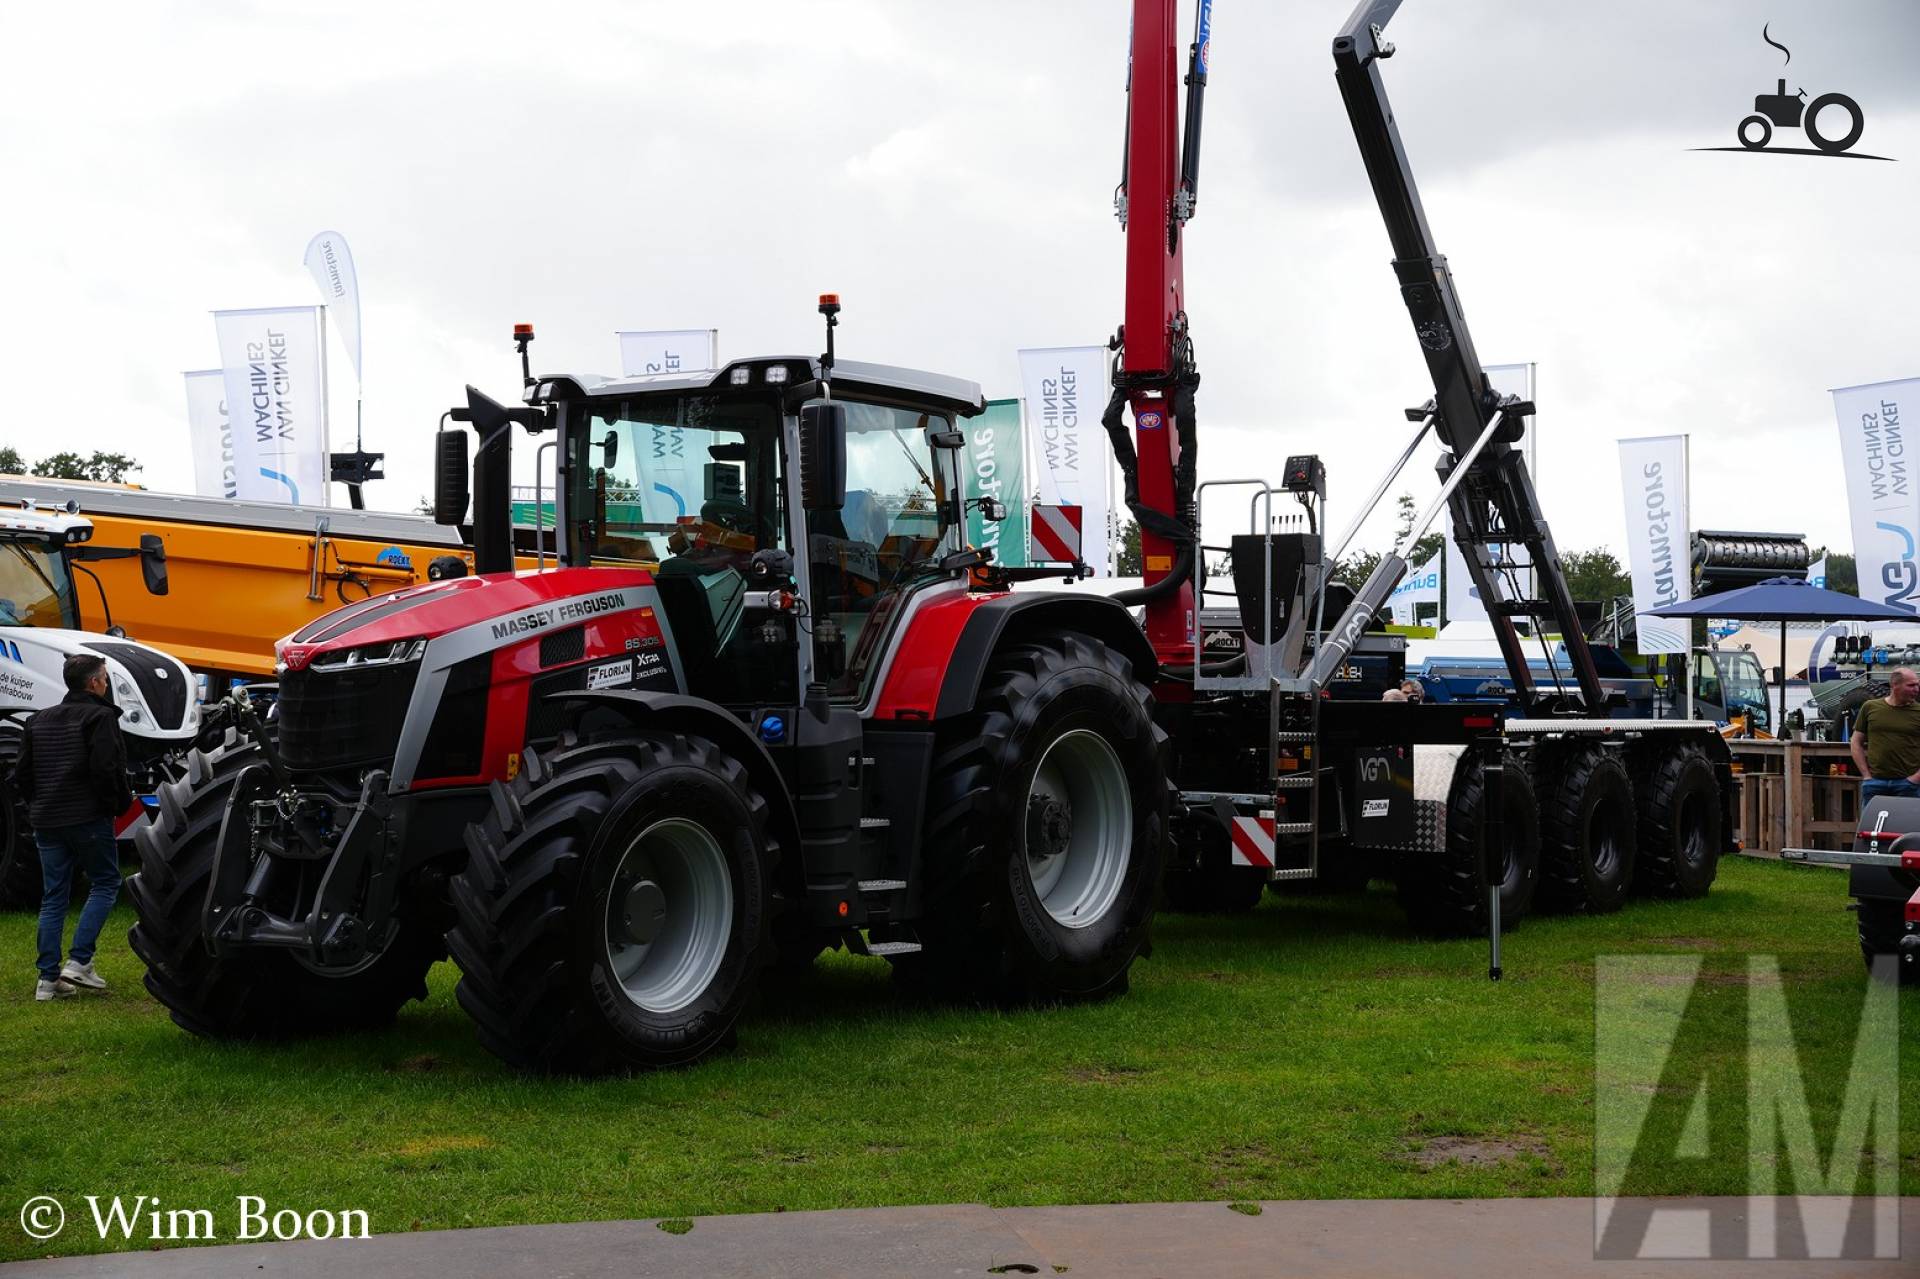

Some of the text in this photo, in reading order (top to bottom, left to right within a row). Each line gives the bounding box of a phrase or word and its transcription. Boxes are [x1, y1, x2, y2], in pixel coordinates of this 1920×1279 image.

[491, 593, 626, 640] MASSEY FERGUSON
[598, 664, 631, 680] FLORIJN
[10, 674, 34, 690] kuiper
